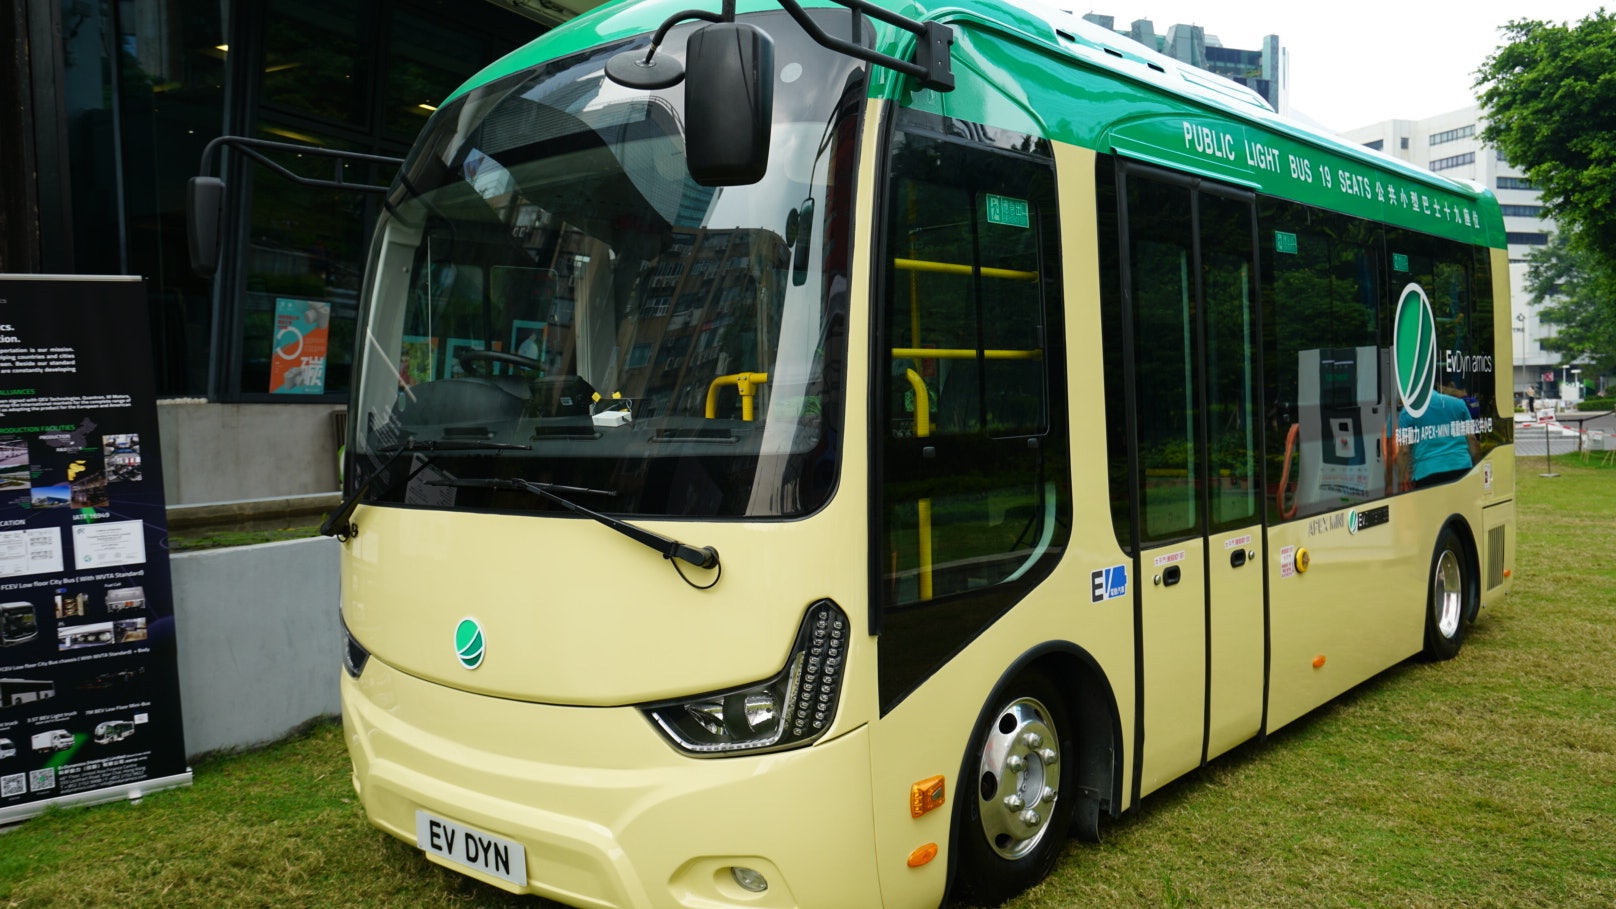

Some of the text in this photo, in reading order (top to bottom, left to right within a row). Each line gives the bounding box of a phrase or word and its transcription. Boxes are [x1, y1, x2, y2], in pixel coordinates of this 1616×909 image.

[1183, 122, 1372, 199] PUBLIC LIGHT BUS 19 SEATS
[1446, 350, 1492, 379] EvDynamics
[429, 819, 510, 876] EV DYN
